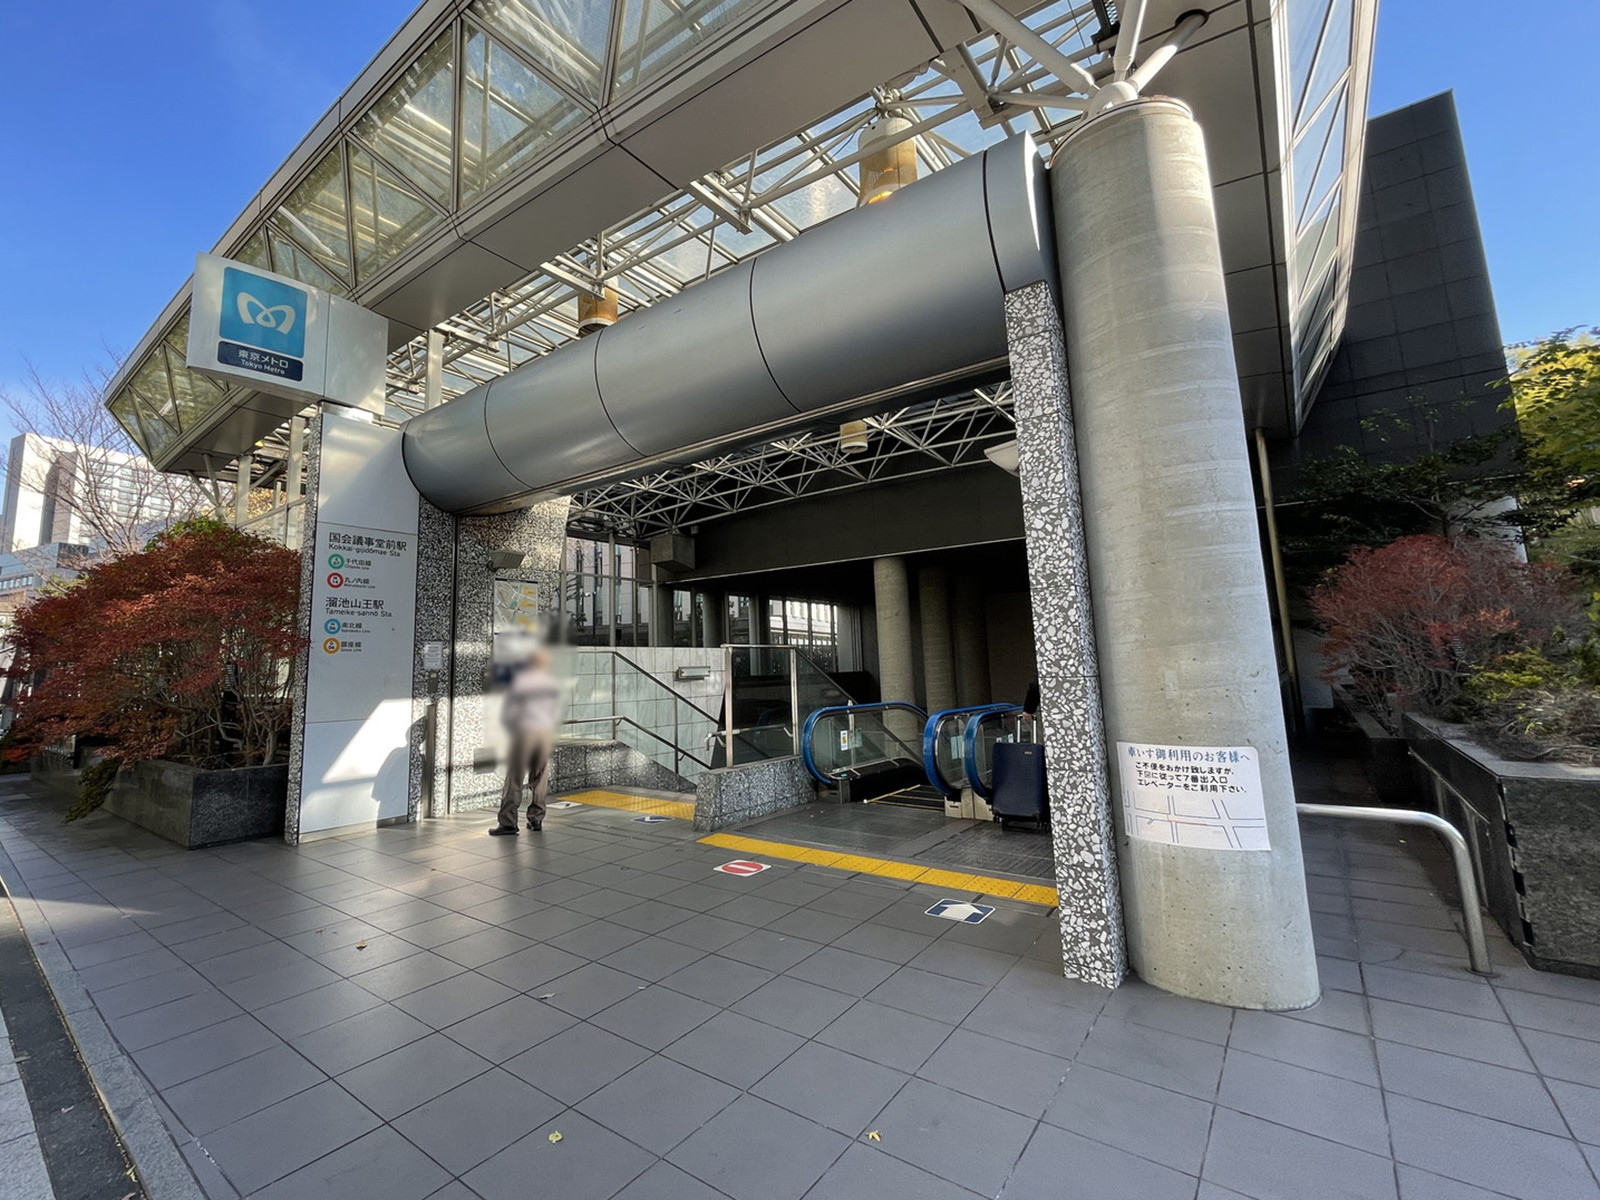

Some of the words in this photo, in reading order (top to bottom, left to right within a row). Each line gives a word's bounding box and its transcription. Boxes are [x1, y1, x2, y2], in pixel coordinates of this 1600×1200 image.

[238, 349, 288, 368] 東京メトロ
[241, 359, 262, 369] Tokyo
[264, 364, 285, 374] Metro
[329, 532, 407, 551] 国会議事堂前駅
[325, 596, 384, 610] 溜池山王駅
[1128, 746, 1250, 763] 車いす御利用のお客様へ
